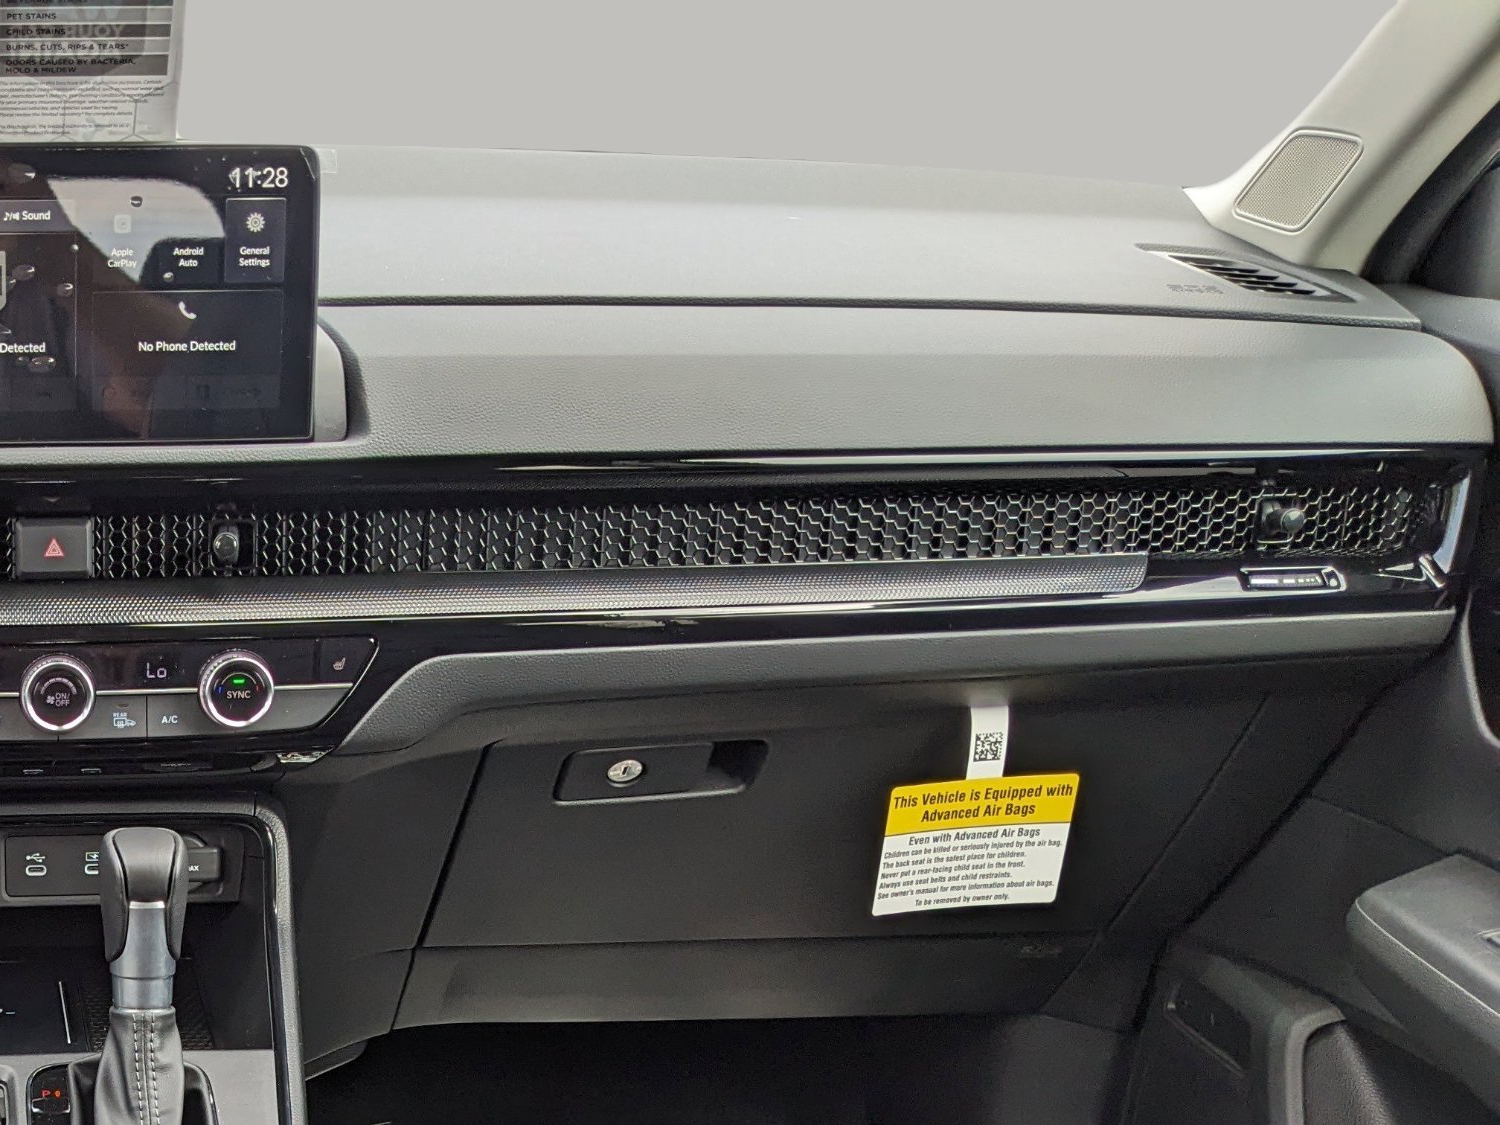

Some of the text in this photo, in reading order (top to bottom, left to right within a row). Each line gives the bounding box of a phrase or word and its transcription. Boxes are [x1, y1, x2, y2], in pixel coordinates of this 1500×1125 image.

[6, 12, 57, 20] PET STAINS
[6, 28, 34, 36] CHILD
[35, 28, 66, 36] STAINS
[6, 58, 88, 66] ODORS CAUSED BY
[6, 66, 31, 74] MOLD
[41, 66, 76, 74] MILDEW
[228, 167, 288, 188] 11:28
[22, 210, 51, 220] Sound
[111, 248, 133, 258] Apple
[173, 247, 204, 256] Android
[240, 246, 270, 255] General
[108, 260, 138, 269] CarPlay
[178, 259, 198, 267] Auto
[239, 258, 270, 268] Settings
[0, 342, 46, 354] Detected
[138, 340, 236, 352] No Phone Detected
[226, 690, 252, 700] SYNC
[161, 715, 179, 724] A/C
[894, 784, 1073, 810] This Vehicle is Equipped with
[920, 803, 1036, 823] Advanced Air Bags
[908, 828, 1042, 846] Even with Advanced Air Bags
[884, 850, 910, 860] Children
[932, 846, 951, 854] killed
[960, 842, 990, 852] seriously
[990, 841, 1014, 850] injured
[1015, 840, 1024, 848] by
[882, 862, 894, 870] The
[895, 860, 910, 868] back
[911, 858, 926, 866] seat
[933, 856, 945, 864] the
[966, 853, 985, 862] place
[880, 872, 899, 880] Never
[900, 870, 911, 878] put
[971, 862, 986, 870] seat
[995, 861, 1006, 869] the
[878, 882, 901, 890] Always
[914, 877, 930, 885] seat
[930, 875, 946, 884] belts
[947, 874, 960, 882] and
[960, 873, 978, 881] child
[877, 892, 889, 900] See
[915, 886, 939, 895] manual
[967, 882, 1005, 890] information
[1006, 880, 1025, 888] about
[923, 898, 932, 906] be
[932, 896, 962, 905] removed
[972, 894, 993, 902] owner
